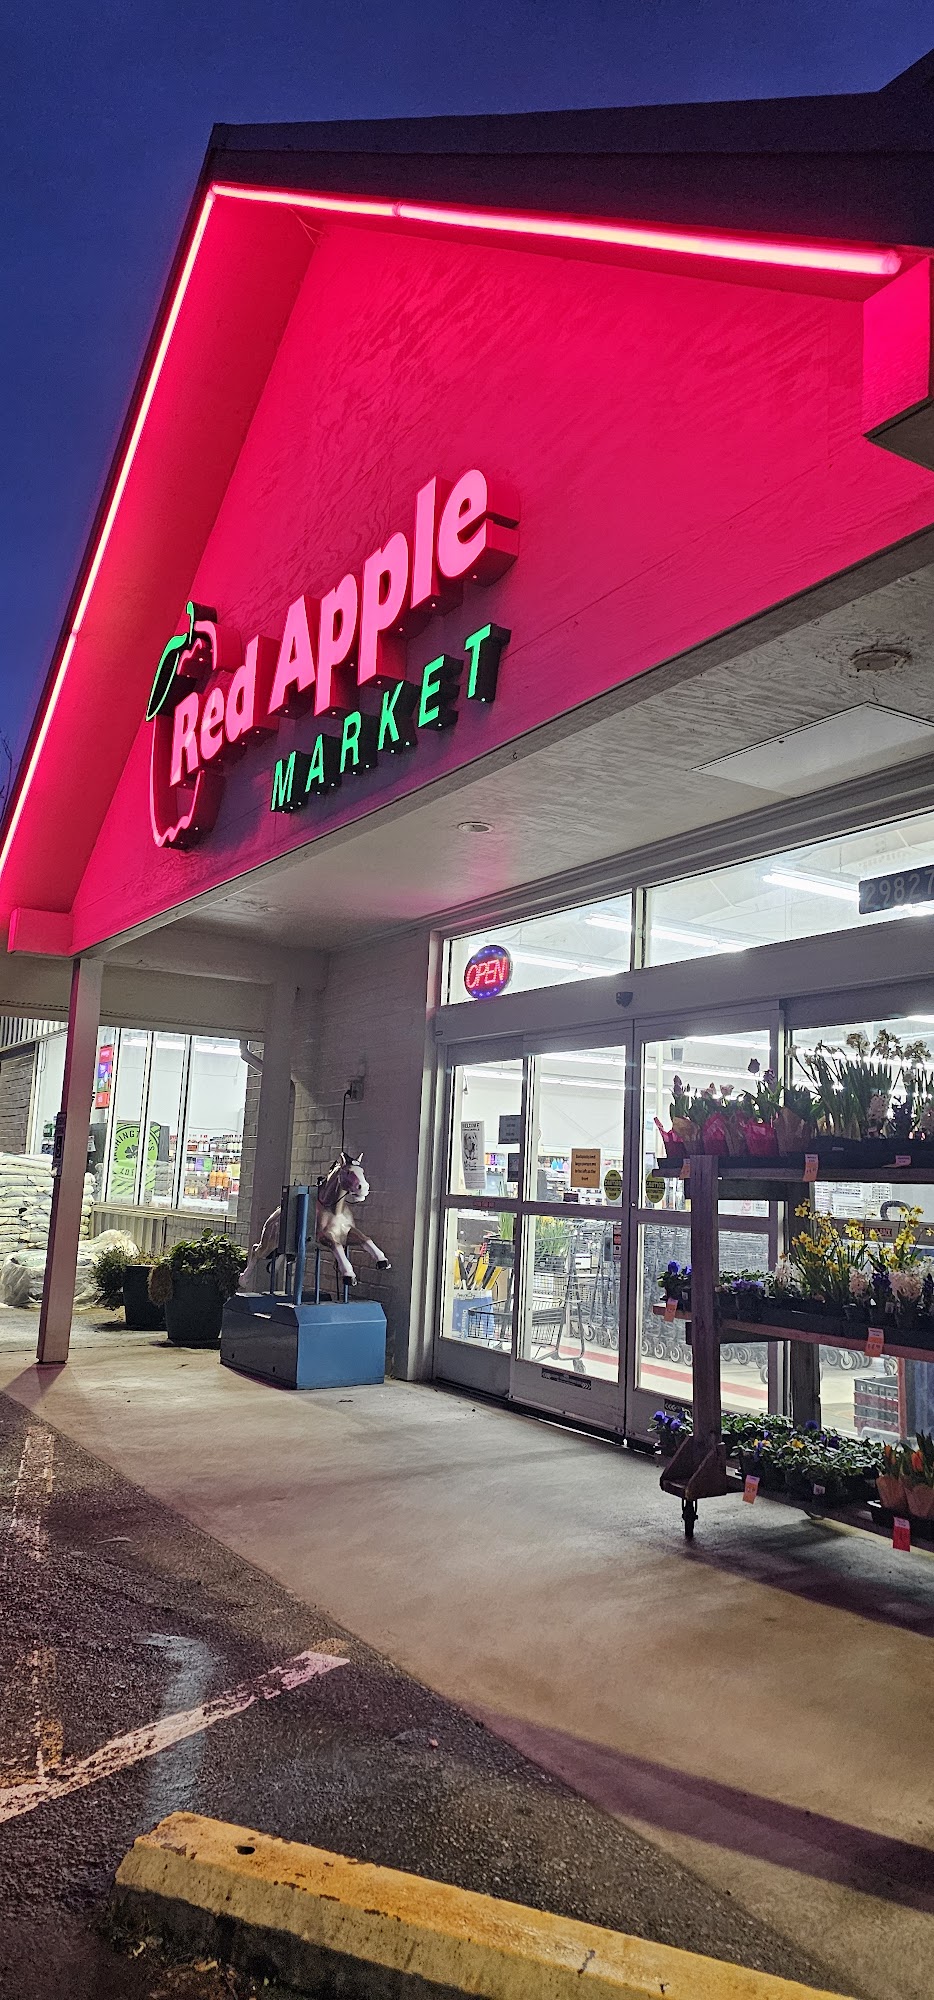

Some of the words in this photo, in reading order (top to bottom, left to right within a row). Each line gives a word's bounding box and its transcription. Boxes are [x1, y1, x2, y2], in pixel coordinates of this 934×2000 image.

[170, 633, 260, 788] Red
[267, 468, 489, 717] Apple
[270, 622, 493, 812] MARKET
[864, 868, 934, 908] 29827
[465, 957, 507, 989] OPEN
